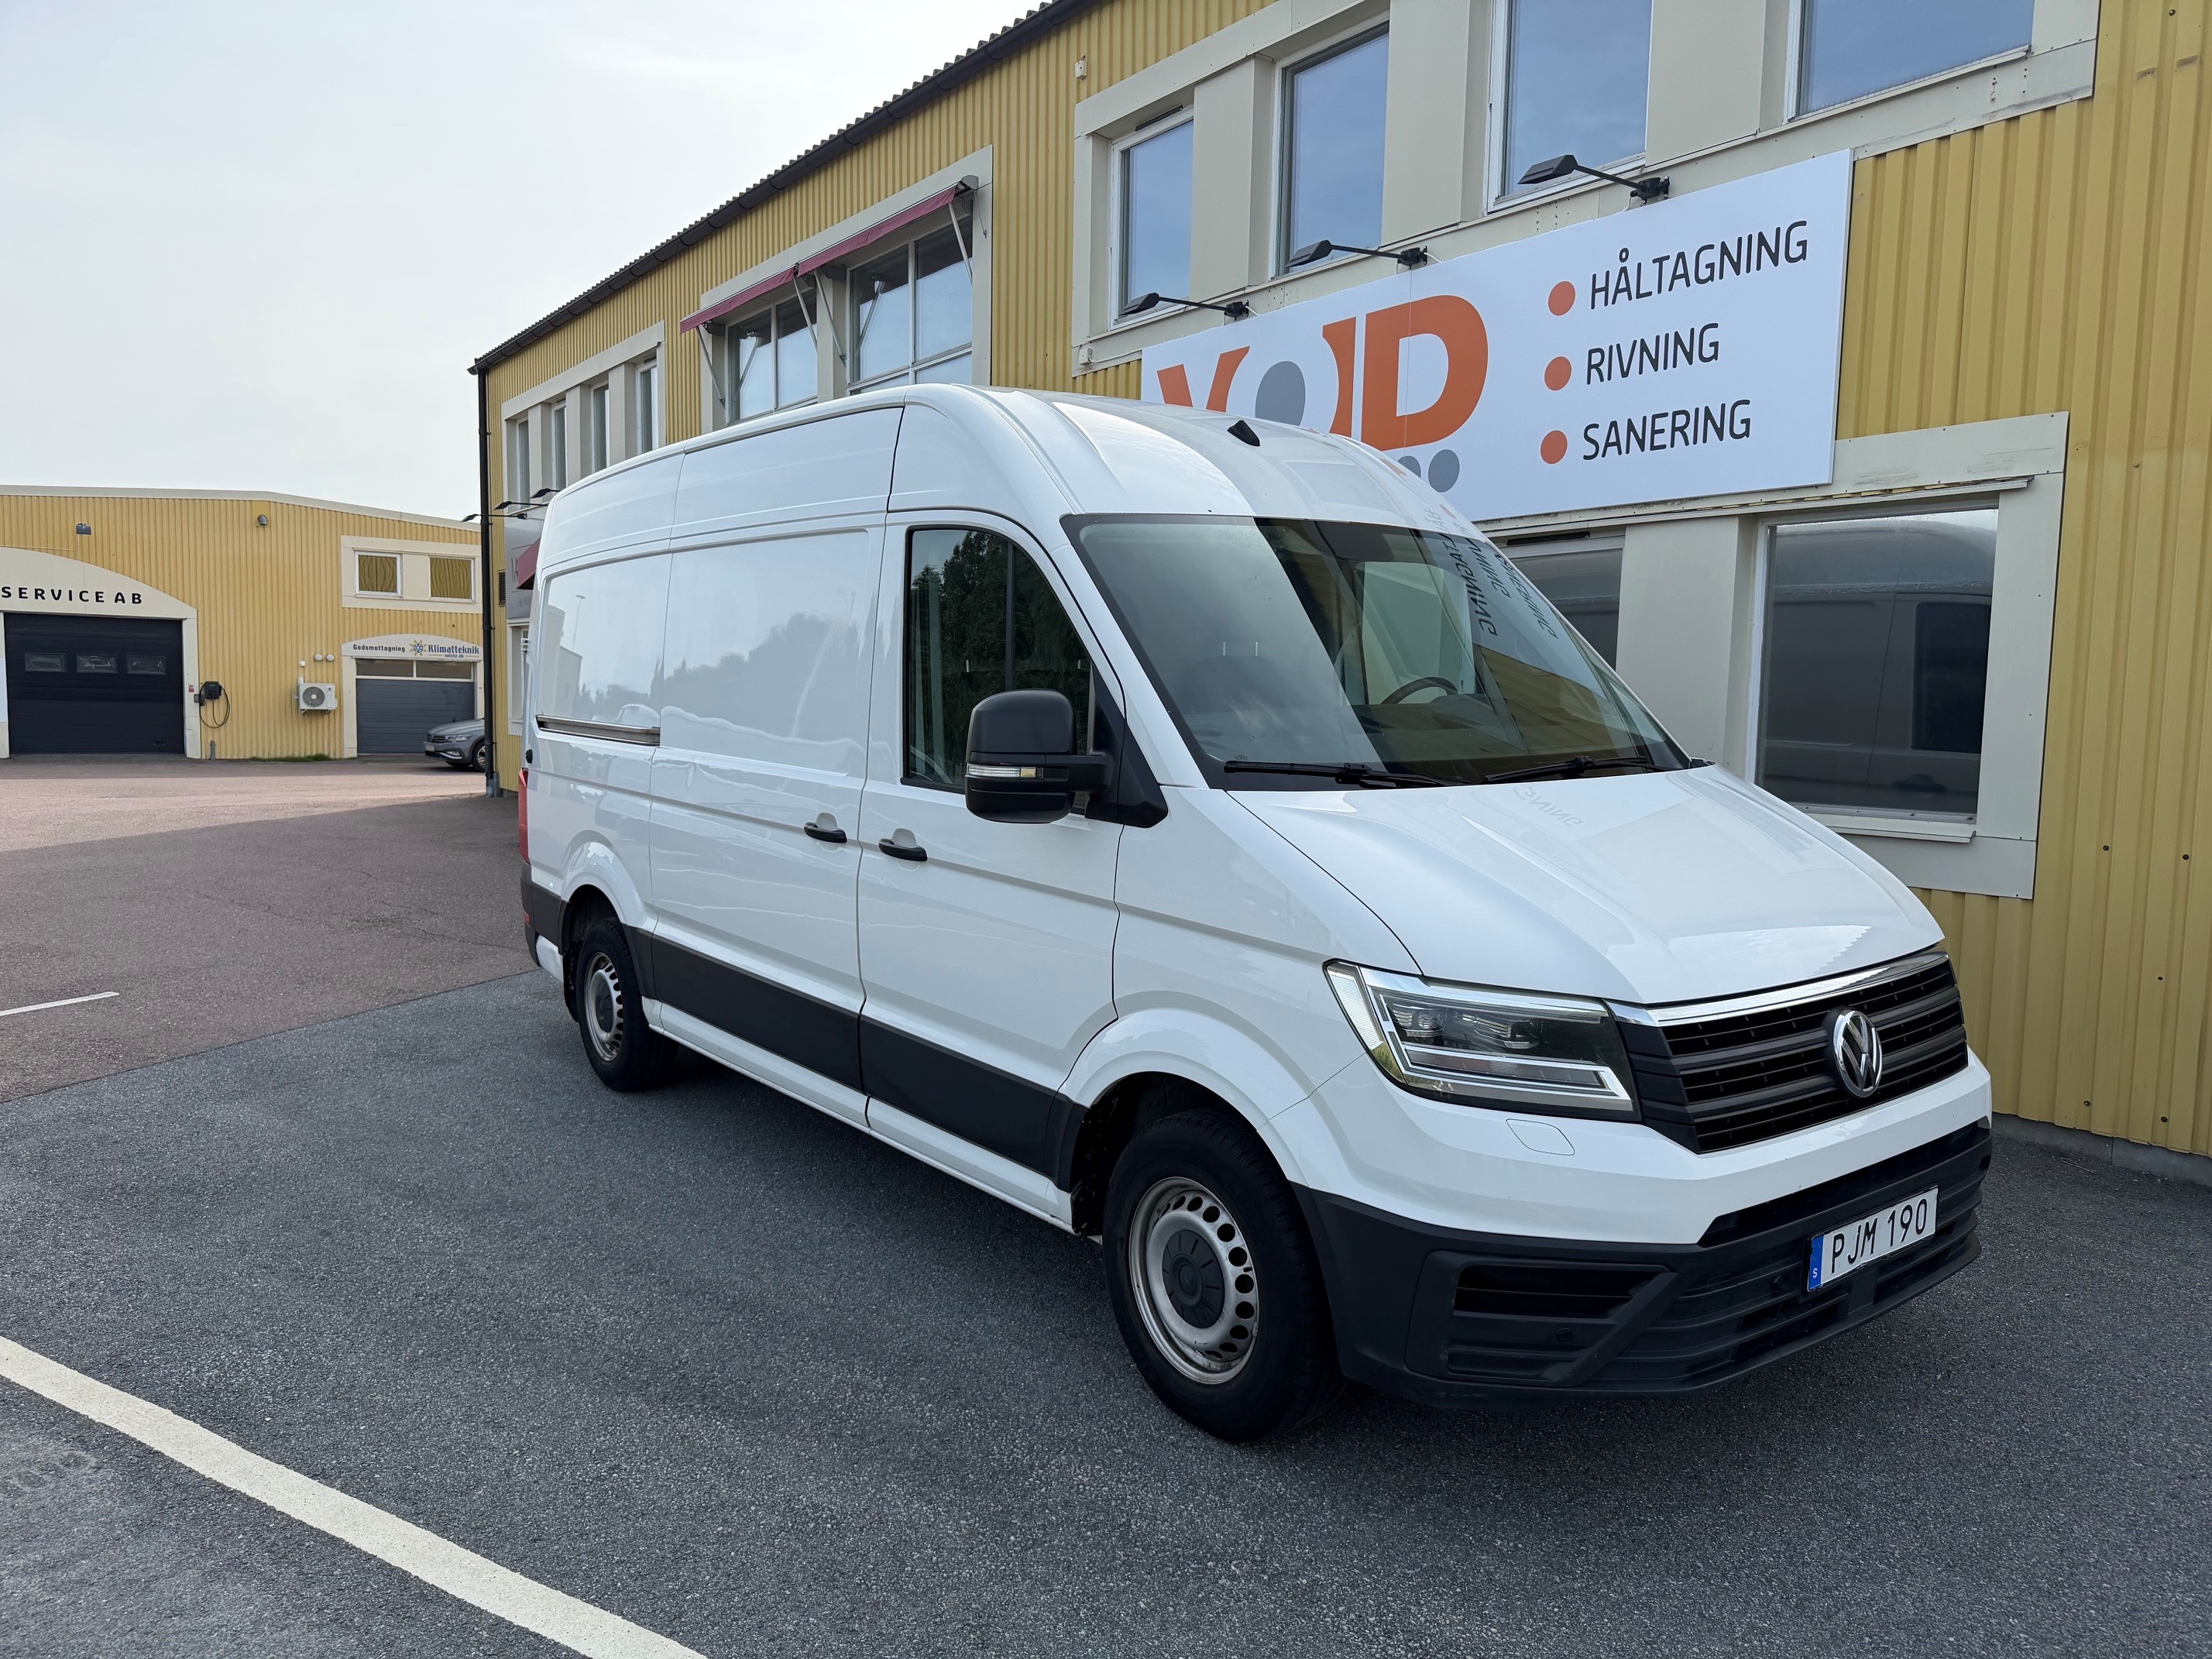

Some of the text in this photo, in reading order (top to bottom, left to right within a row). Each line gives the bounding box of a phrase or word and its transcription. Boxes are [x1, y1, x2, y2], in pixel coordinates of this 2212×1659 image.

[1590, 220, 1808, 310] HÅLTAGNING
[1586, 322, 1719, 385] RIVNING
[1582, 399, 1750, 461] SANERING
[1, 586, 143, 604] SERVICE AB
[352, 644, 406, 653] Godsmottagning
[428, 644, 479, 654] Klimatteknik
[1831, 1198, 1928, 1274] PJM 190
[1812, 1267, 1819, 1279] S
